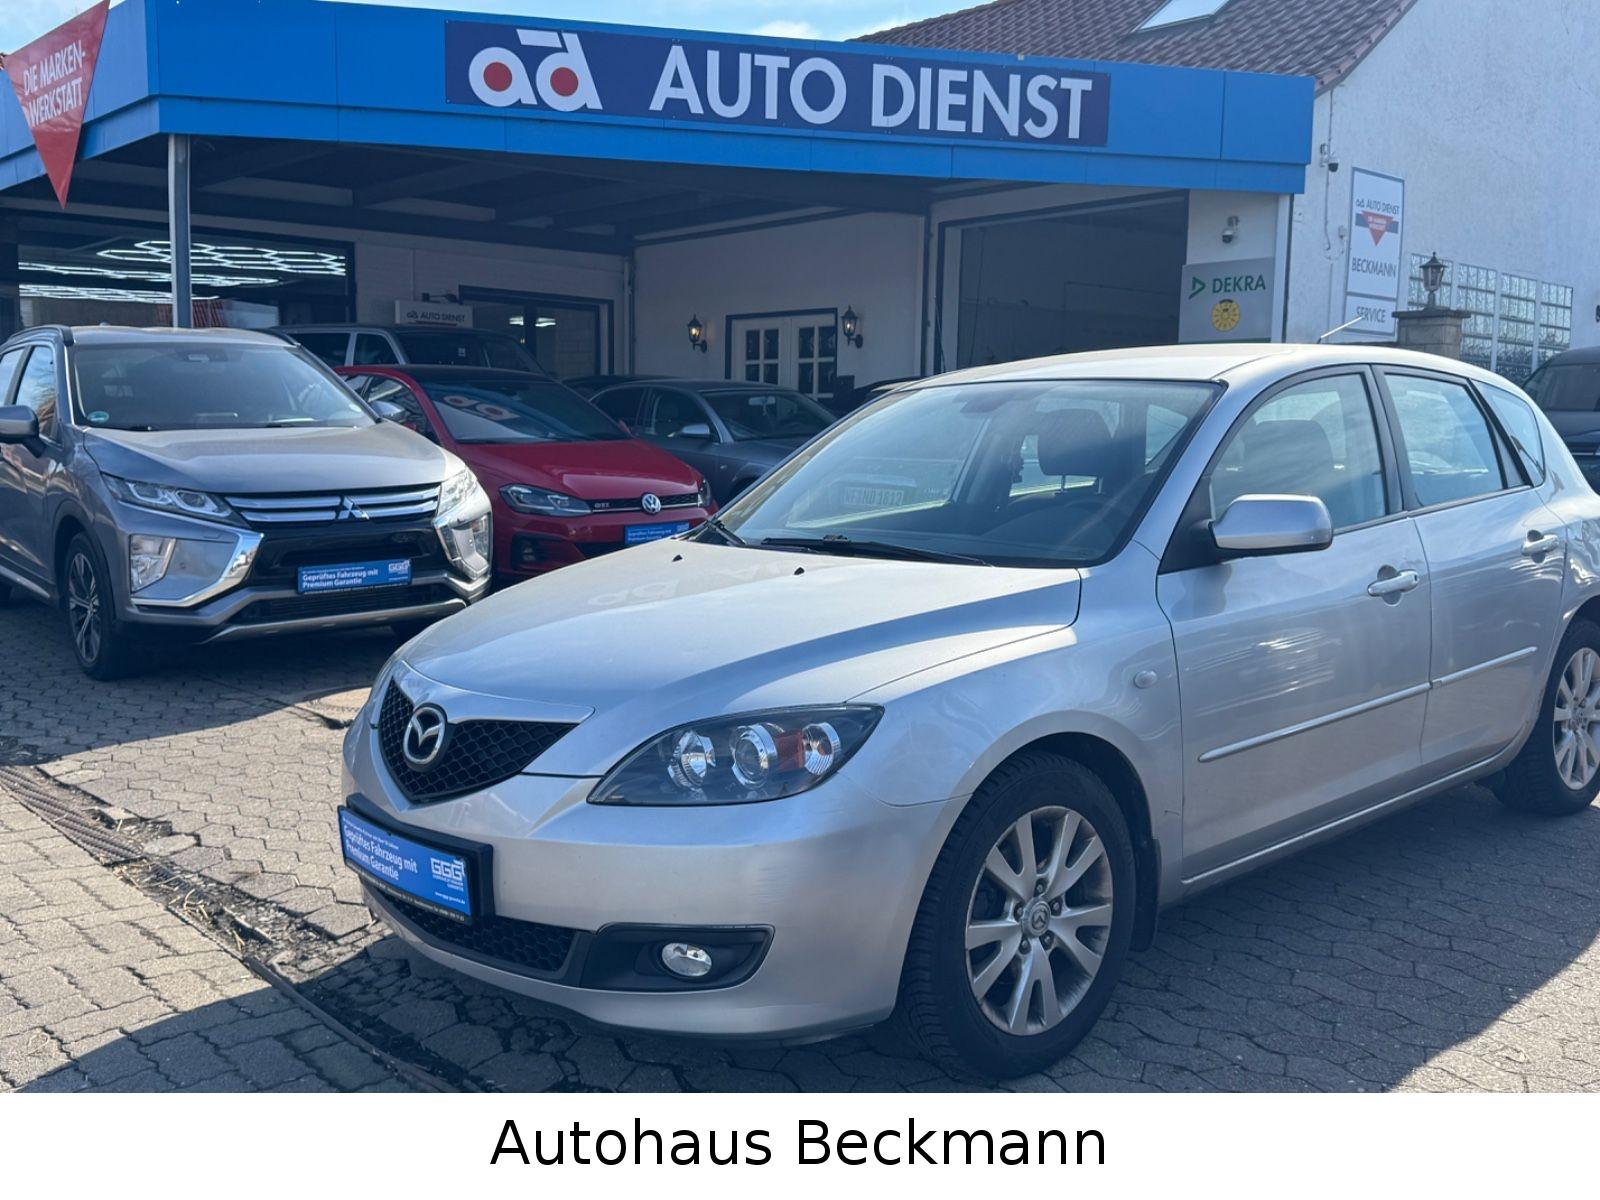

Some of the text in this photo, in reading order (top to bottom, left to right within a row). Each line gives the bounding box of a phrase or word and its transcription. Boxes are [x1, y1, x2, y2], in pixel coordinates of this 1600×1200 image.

[23, 40, 86, 96] DIE MARKEN-
[28, 77, 83, 128] WERKSTATT
[648, 45, 847, 124] AUTO
[871, 63, 1093, 140] DIENST
[1366, 199, 1382, 211] AUTO
[1382, 202, 1400, 215] DIENST
[1352, 257, 1397, 278] BECKMANN
[1212, 274, 1266, 293] DEKRA
[420, 311, 440, 320] AUTO
[1356, 306, 1387, 323] SERVICE
[302, 572, 336, 582] Geprüftes
[336, 570, 367, 579] Fahrzeug
[367, 568, 379, 577] mit
[302, 578, 363, 588] Premium Garantie
[343, 824, 371, 852] Geprüftes
[371, 841, 403, 870] Fahrzeug
[403, 858, 418, 874] mit
[345, 839, 400, 880] Premium Garantie
[430, 857, 465, 881] GGG
